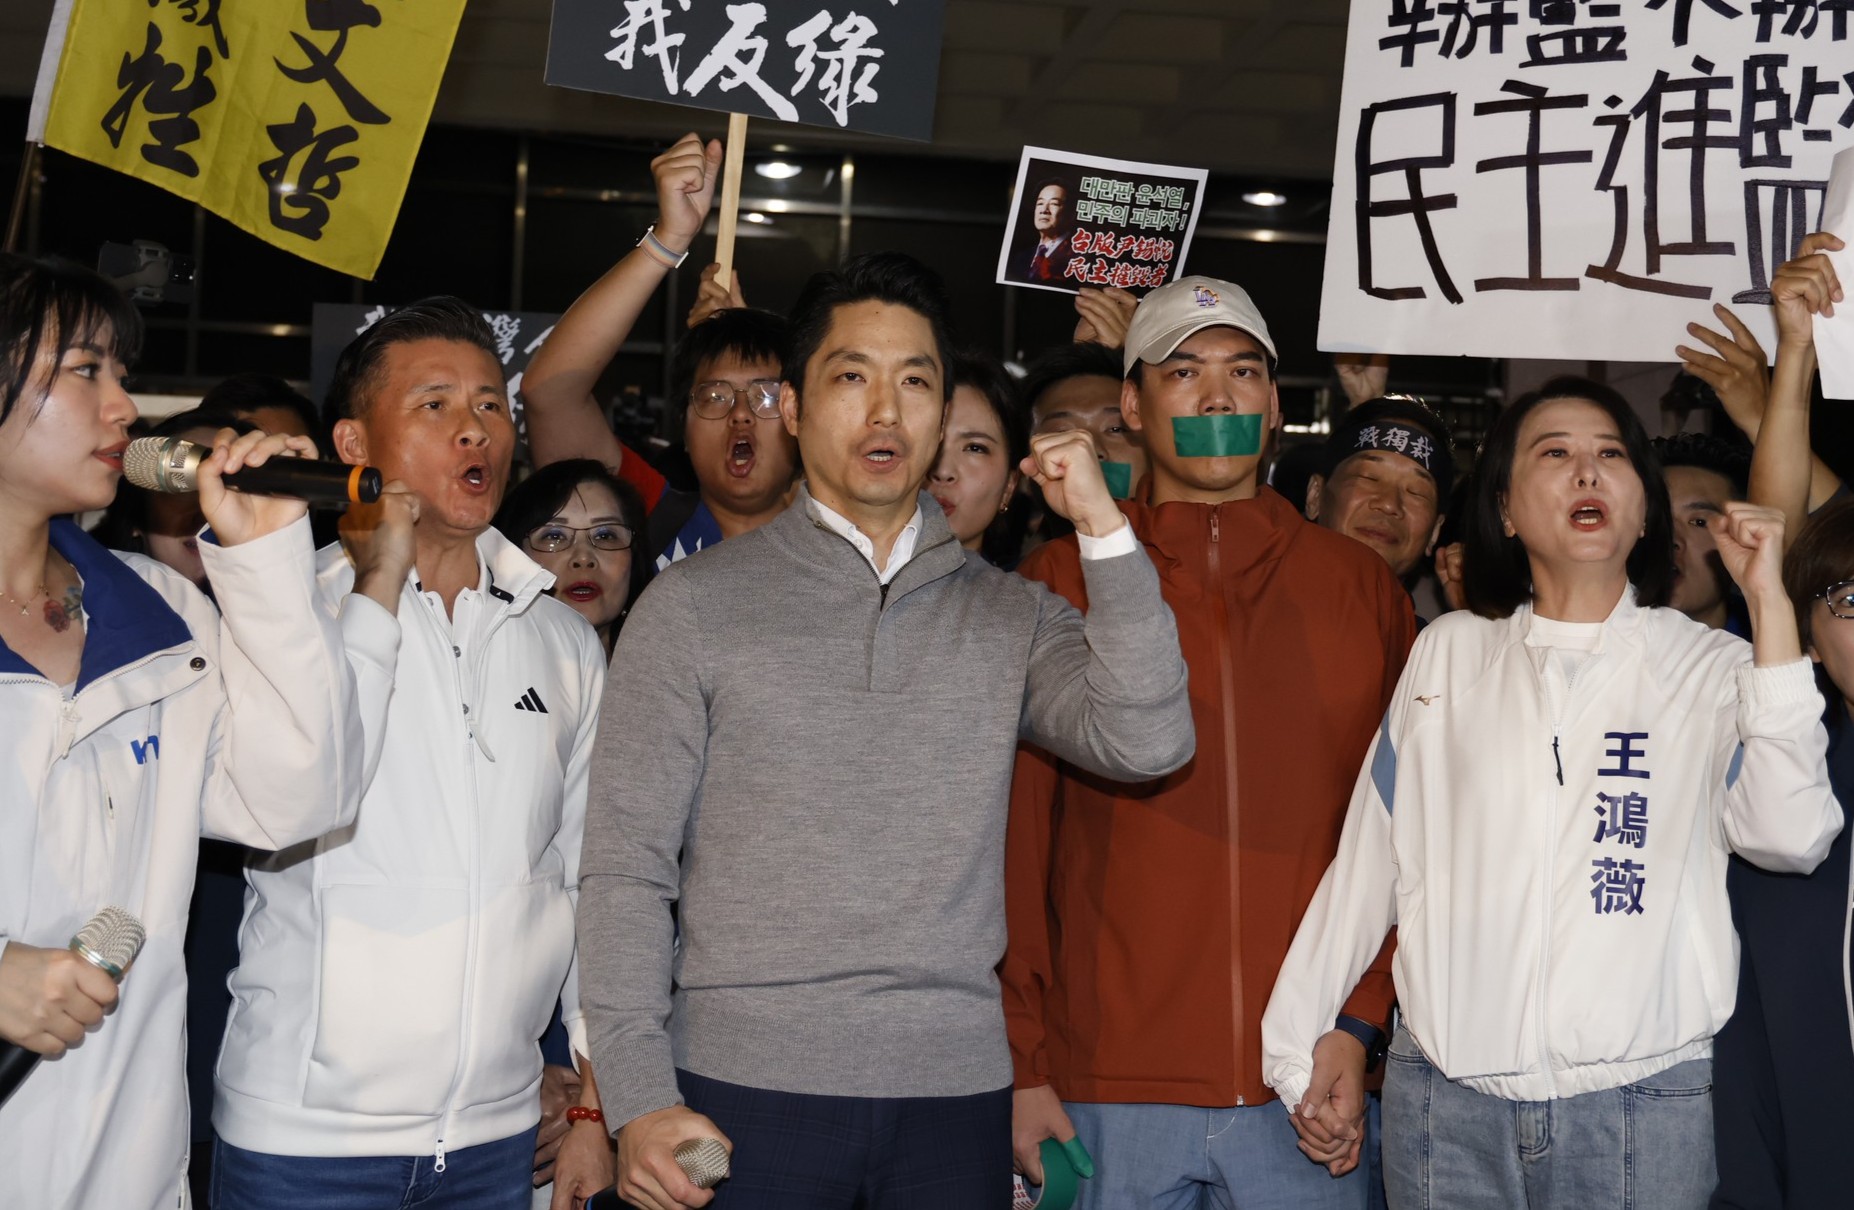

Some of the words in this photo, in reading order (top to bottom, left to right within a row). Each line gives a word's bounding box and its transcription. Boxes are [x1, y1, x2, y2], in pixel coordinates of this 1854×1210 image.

[1080, 177, 1135, 203] 대만판
[1135, 184, 1190, 211] 윤석열,
[1076, 200, 1130, 227] 민주의
[1064, 257, 1169, 288] 民主摧毀者
[1354, 425, 1434, 470] 戰獨裁
[1590, 732, 1650, 915] 王鴻薇
